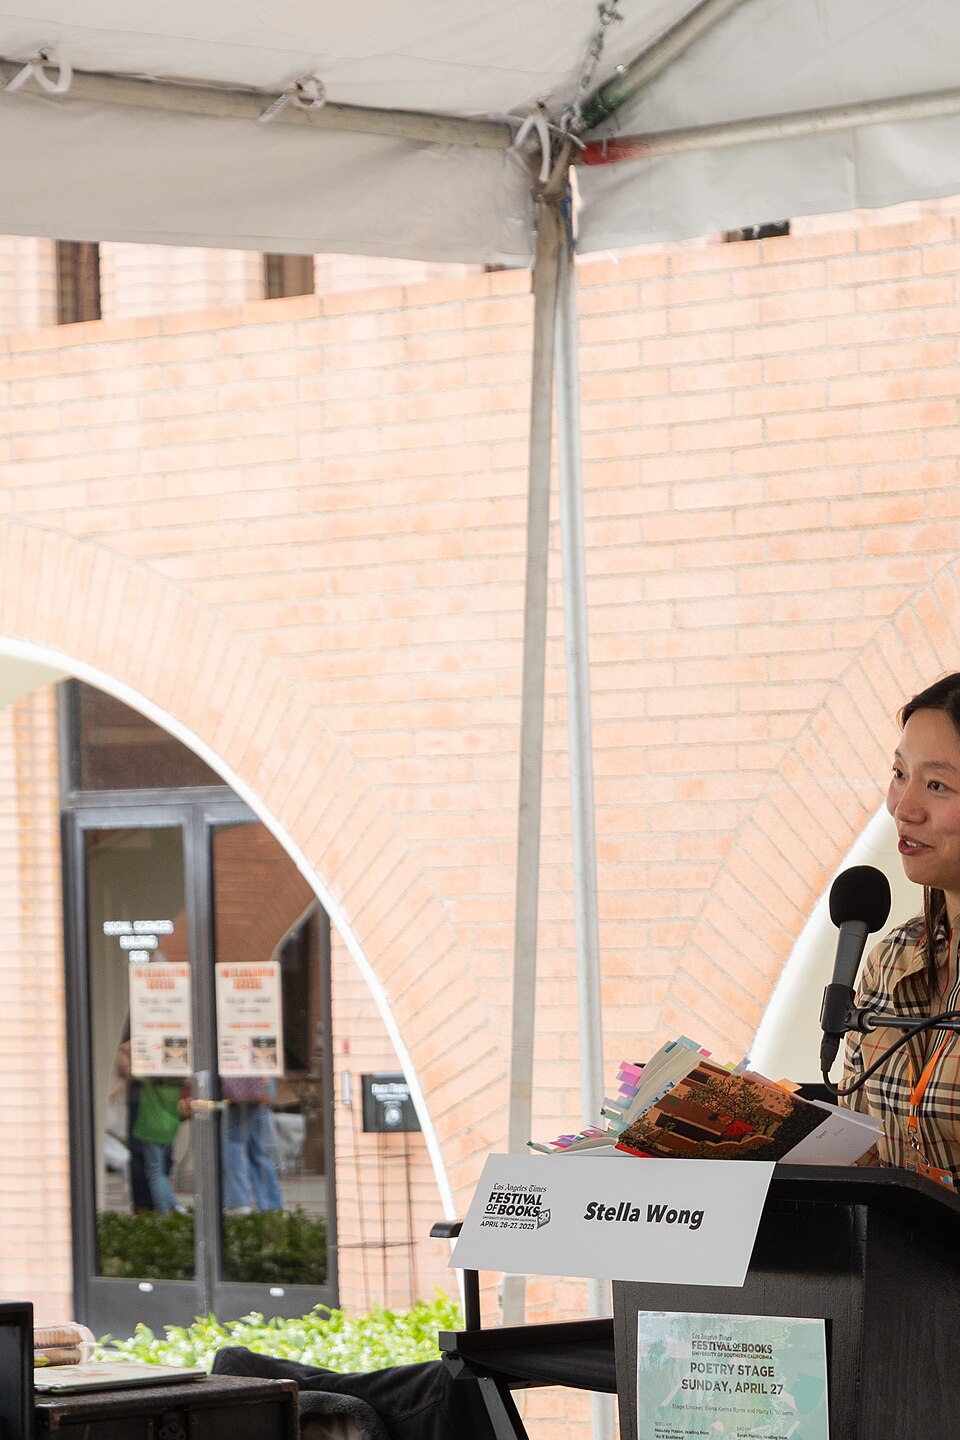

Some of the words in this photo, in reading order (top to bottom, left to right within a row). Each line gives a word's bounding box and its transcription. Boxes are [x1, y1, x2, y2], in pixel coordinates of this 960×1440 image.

[505, 1184, 527, 1192] Angeles
[489, 1192, 542, 1205] FESTIVAL
[486, 1204, 498, 1212] OF
[497, 1205, 540, 1217] BOOKS
[583, 1201, 640, 1223] Stella
[646, 1204, 704, 1230] Wong
[519, 1222, 535, 1230] 2025
[692, 1340, 732, 1351] FESTIVAL
[742, 1343, 772, 1353] BOOKS
[690, 1362, 734, 1375] POETRY
[738, 1365, 774, 1377] STAGE
[682, 1379, 732, 1394] SUNDAY,
[735, 1382, 767, 1394] APRIL
[770, 1384, 783, 1395] 27
